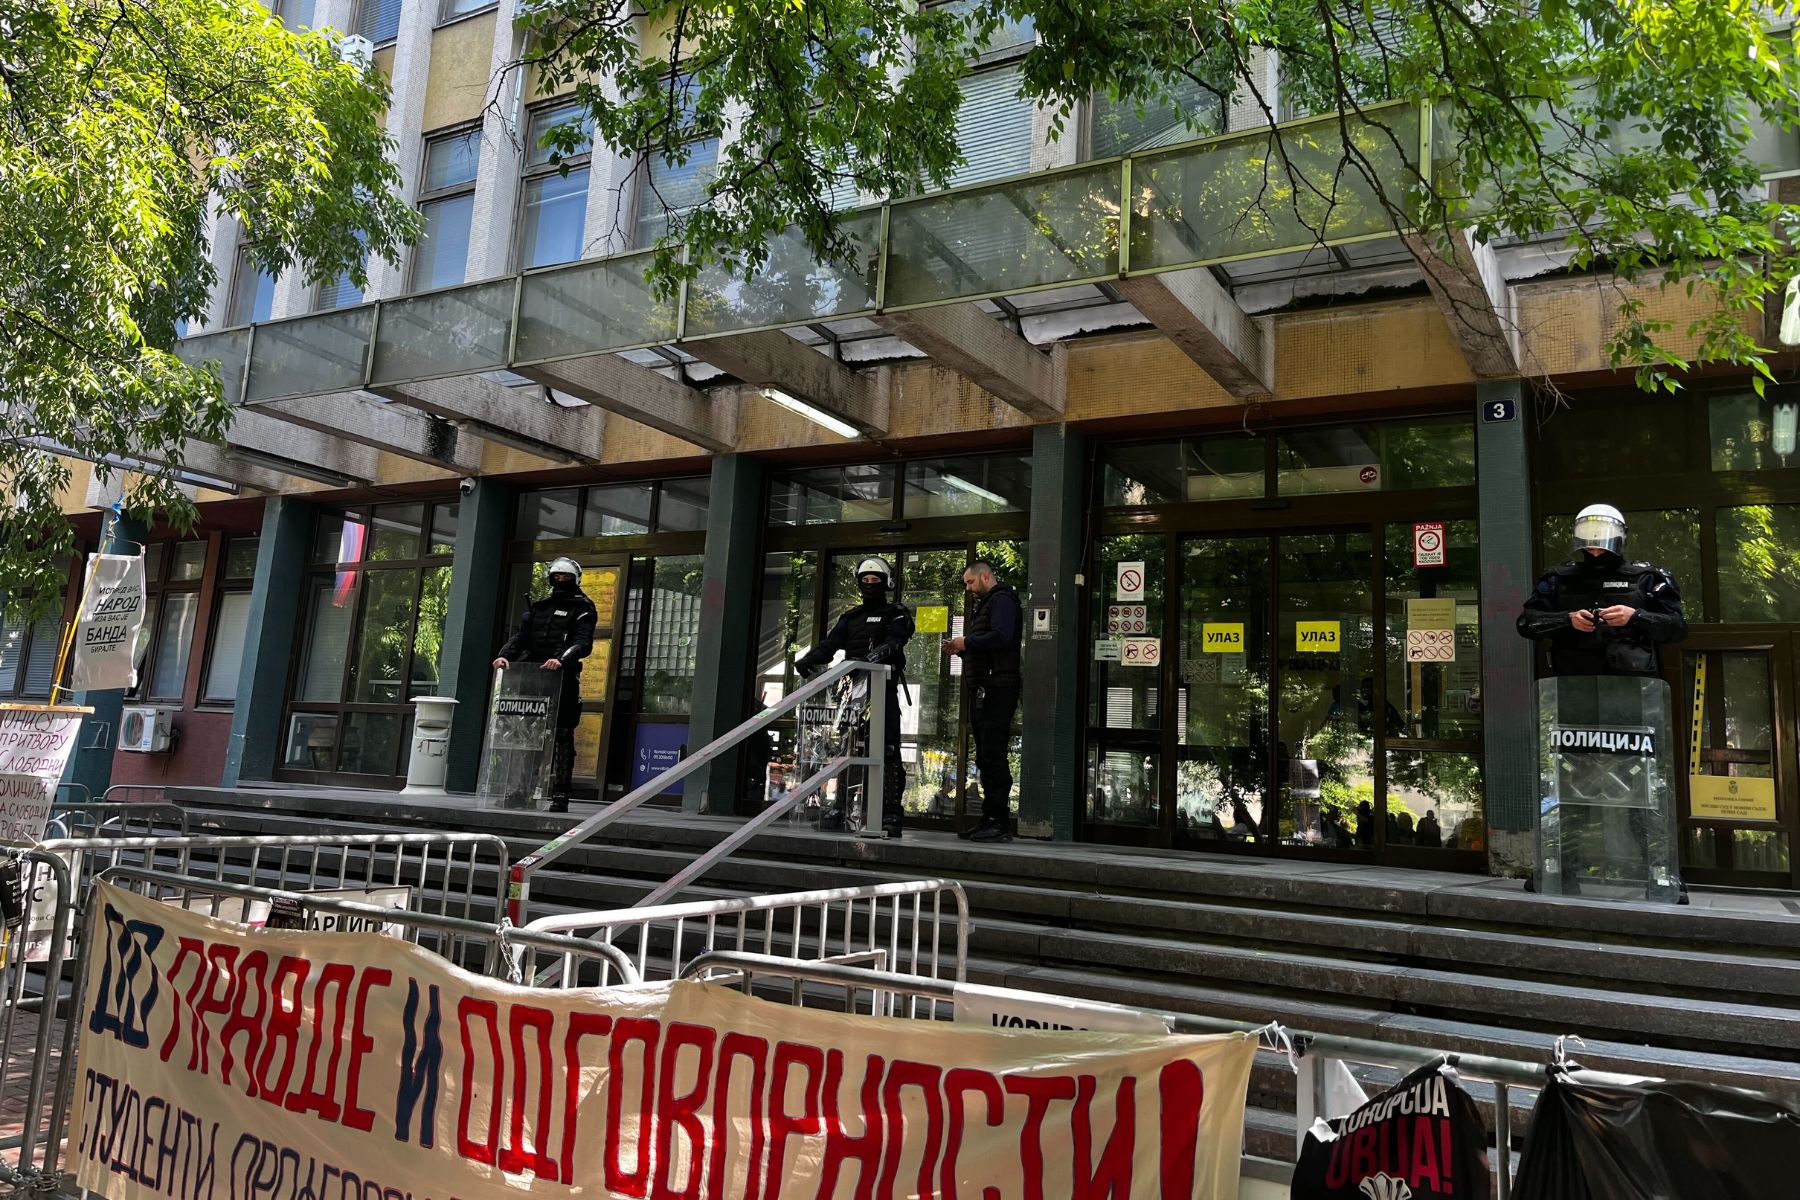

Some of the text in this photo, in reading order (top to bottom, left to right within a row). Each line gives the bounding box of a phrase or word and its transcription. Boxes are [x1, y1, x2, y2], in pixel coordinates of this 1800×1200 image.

[1493, 403, 1505, 418] 3
[95, 595, 141, 612] НАРОД
[107, 614, 121, 622] ВАС
[86, 625, 127, 642] БАНДА
[1207, 632, 1240, 643] УЛАЗ
[1301, 631, 1336, 642] УЛАЗ
[91, 644, 117, 654] БИРАЈТЕ
[0, 732, 69, 751] ПРИТВОРУ
[1550, 731, 1654, 753] ПОЛИЦИЈА
[0, 780, 48, 801] ОЛИЦИЈА
[89, 903, 1204, 1200] ДО ПРАВДЕ И ОДГОВОРНОСТИ!
[1325, 1115, 1454, 1195] UBIJA!
